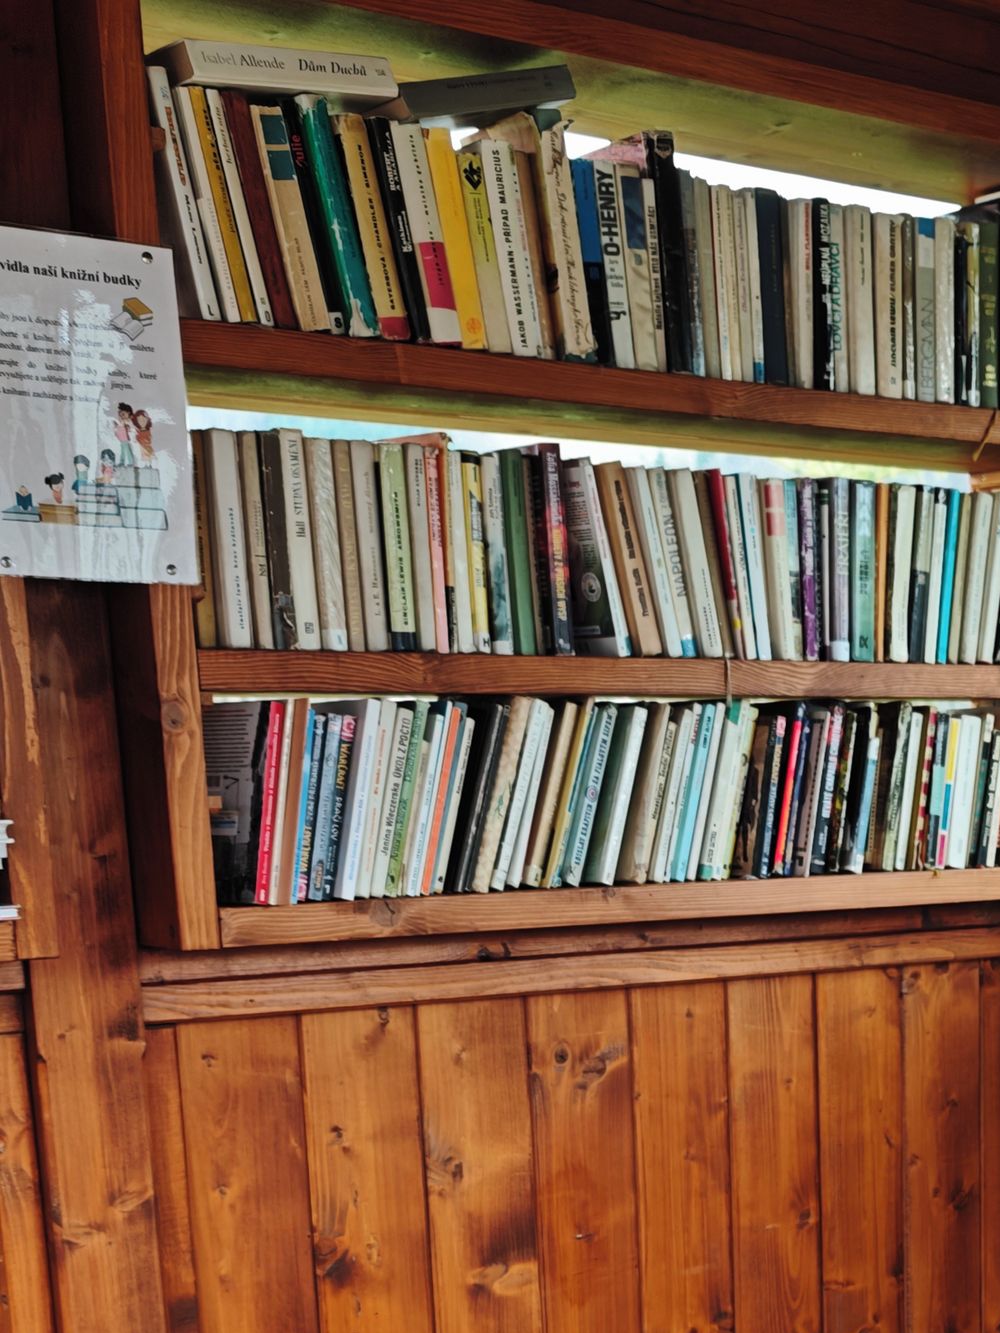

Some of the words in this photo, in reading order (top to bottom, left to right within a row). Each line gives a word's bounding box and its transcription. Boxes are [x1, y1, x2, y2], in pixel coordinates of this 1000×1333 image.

[201, 52, 236, 65] Isabel
[239, 54, 285, 70] Allende
[299, 59, 327, 73] Dům
[331, 61, 367, 77] Duchů
[292, 135, 307, 167] Julie
[358, 144, 370, 188] SIMENON
[385, 152, 396, 191] ROBERT
[492, 149, 507, 205] MAURICIUS
[369, 197, 382, 248] CHANDLER
[501, 209, 513, 243] PŘÍPAD
[820, 203, 830, 243] MOZAIKA
[33, 264, 58, 278] naší
[61, 267, 100, 282] knižní
[103, 272, 141, 289] budky
[508, 250, 523, 315] WASSERMANN
[830, 242, 841, 296] DRAVCI
[519, 320, 528, 348] JAKOB
[294, 482, 305, 516] STUDNA
[295, 520, 307, 538] Hall
[394, 491, 403, 551] ARROWSMITH
[667, 513, 688, 598] NAPOLEON
[401, 586, 409, 626] SINCLAIR
[337, 742, 349, 790] WARCRAFT
[386, 782, 400, 827] Wieczerska
[300, 825, 313, 872] WARCRAFT
[331, 822, 340, 841] LOV
[380, 828, 393, 857] Janina
